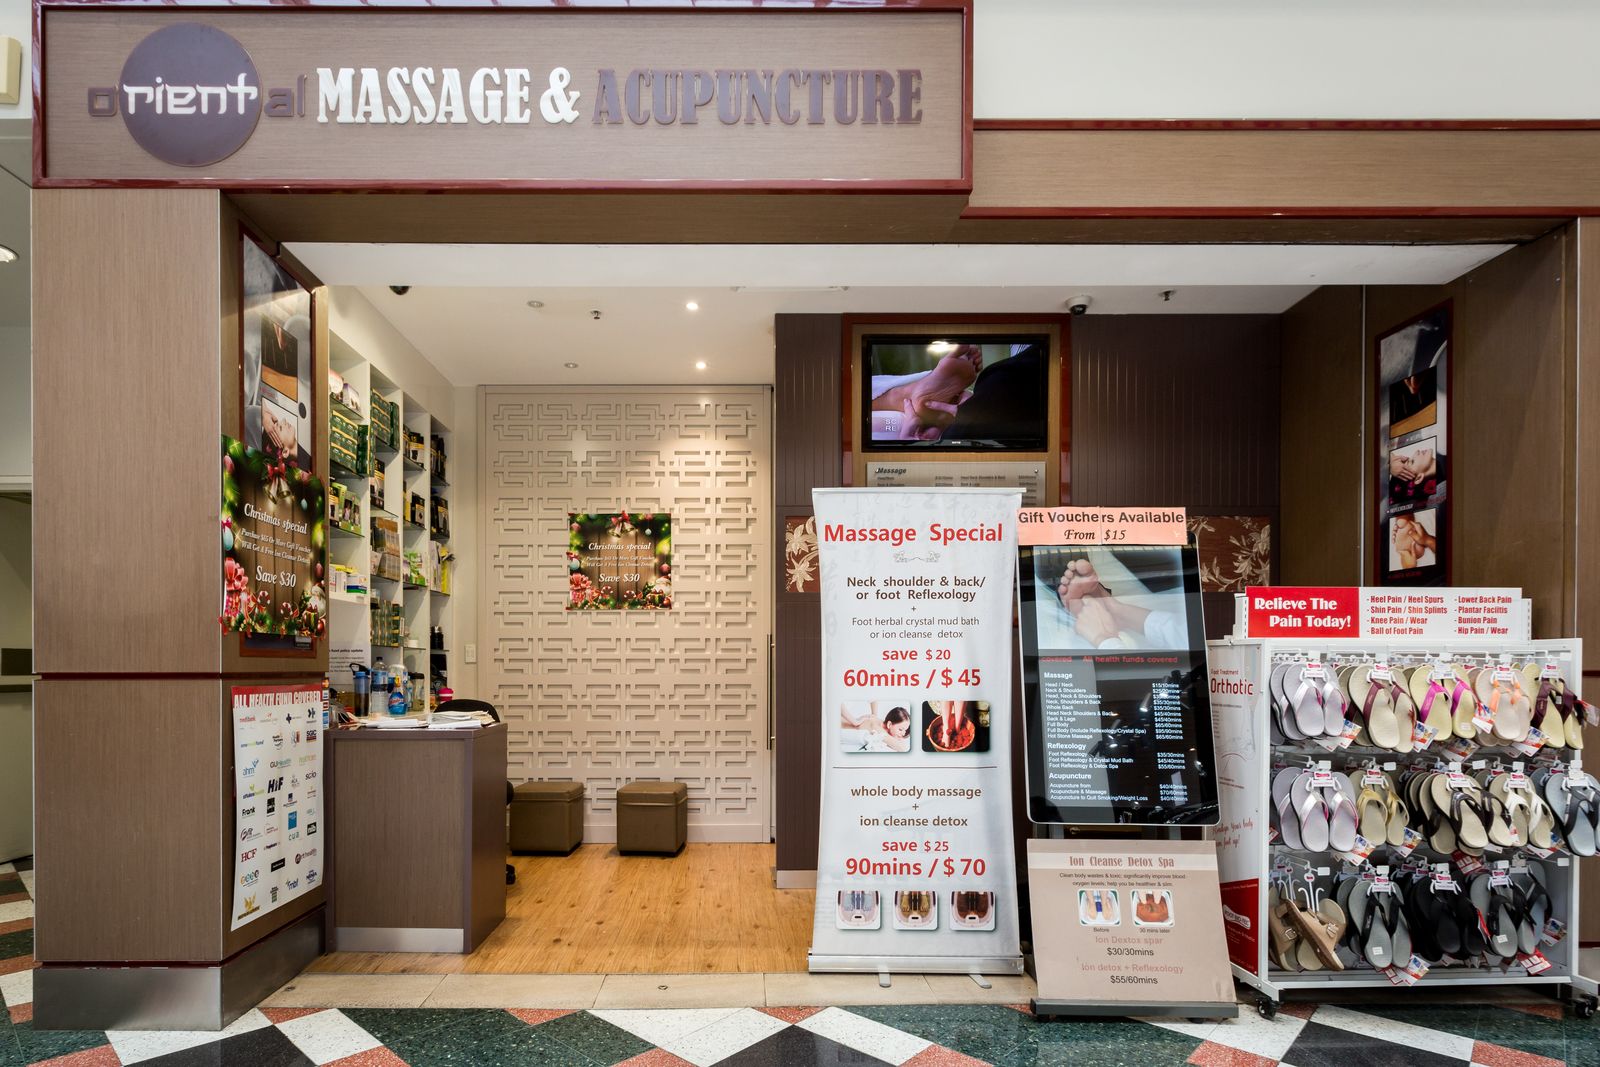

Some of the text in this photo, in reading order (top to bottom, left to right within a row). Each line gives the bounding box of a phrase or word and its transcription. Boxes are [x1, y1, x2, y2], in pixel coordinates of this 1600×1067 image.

[317, 67, 531, 124] MASSAGE
[540, 67, 580, 124] &
[592, 69, 923, 126] ACUPUNCTURE
[244, 503, 308, 535] Christmas special
[1018, 511, 1184, 523] Gift Vouchers Available
[824, 523, 1003, 547] Massage Special
[1064, 529, 1126, 541] From $15
[588, 542, 652, 552] Christmas special
[255, 566, 297, 588] Save $30
[599, 573, 640, 582] Save $30
[847, 576, 986, 588] Neck shoulder & back/
[856, 589, 976, 602] or foot Reflexology
[1424, 596, 1445, 604] Spurs
[1254, 597, 1338, 610] Relieve The
[1370, 606, 1448, 614] Shin Pain Shin Splints
[1458, 606, 1482, 614] Plantar
[852, 617, 980, 628] Foot herbal crystal mud bath
[1269, 614, 1352, 630] Pain Today!
[1370, 616, 1428, 624] Knee Pain Wear
[1458, 616, 1498, 624] Bunion Pain
[869, 630, 963, 639] or ion cleanse detox
[1370, 627, 1424, 635] Ball of Foot Pain
[1457, 626, 1509, 635] Hip Pain Wear
[882, 650, 918, 661] save
[843, 668, 920, 687] 60mins
[1044, 672, 1073, 680] Massage
[1210, 678, 1254, 696] Orthotic
[234, 694, 248, 709] ALL
[249, 692, 275, 707] HEALTH
[293, 690, 321, 704] COVERED
[1048, 743, 1087, 751] Reflexology
[1049, 773, 1092, 781] Acupuncture
[850, 785, 982, 799] whole body massage
[242, 806, 256, 817] Frank
[859, 815, 968, 827] ion cleanse detox
[882, 841, 918, 852] save
[240, 848, 258, 863] HCF
[846, 857, 922, 876] 90mins
[1069, 855, 1175, 869] Ion Cleanse Detox Spa
[1107, 947, 1155, 956] $30/30mins
[1131, 964, 1184, 974] Reflexology
[1110, 975, 1159, 985] $55/60mins
